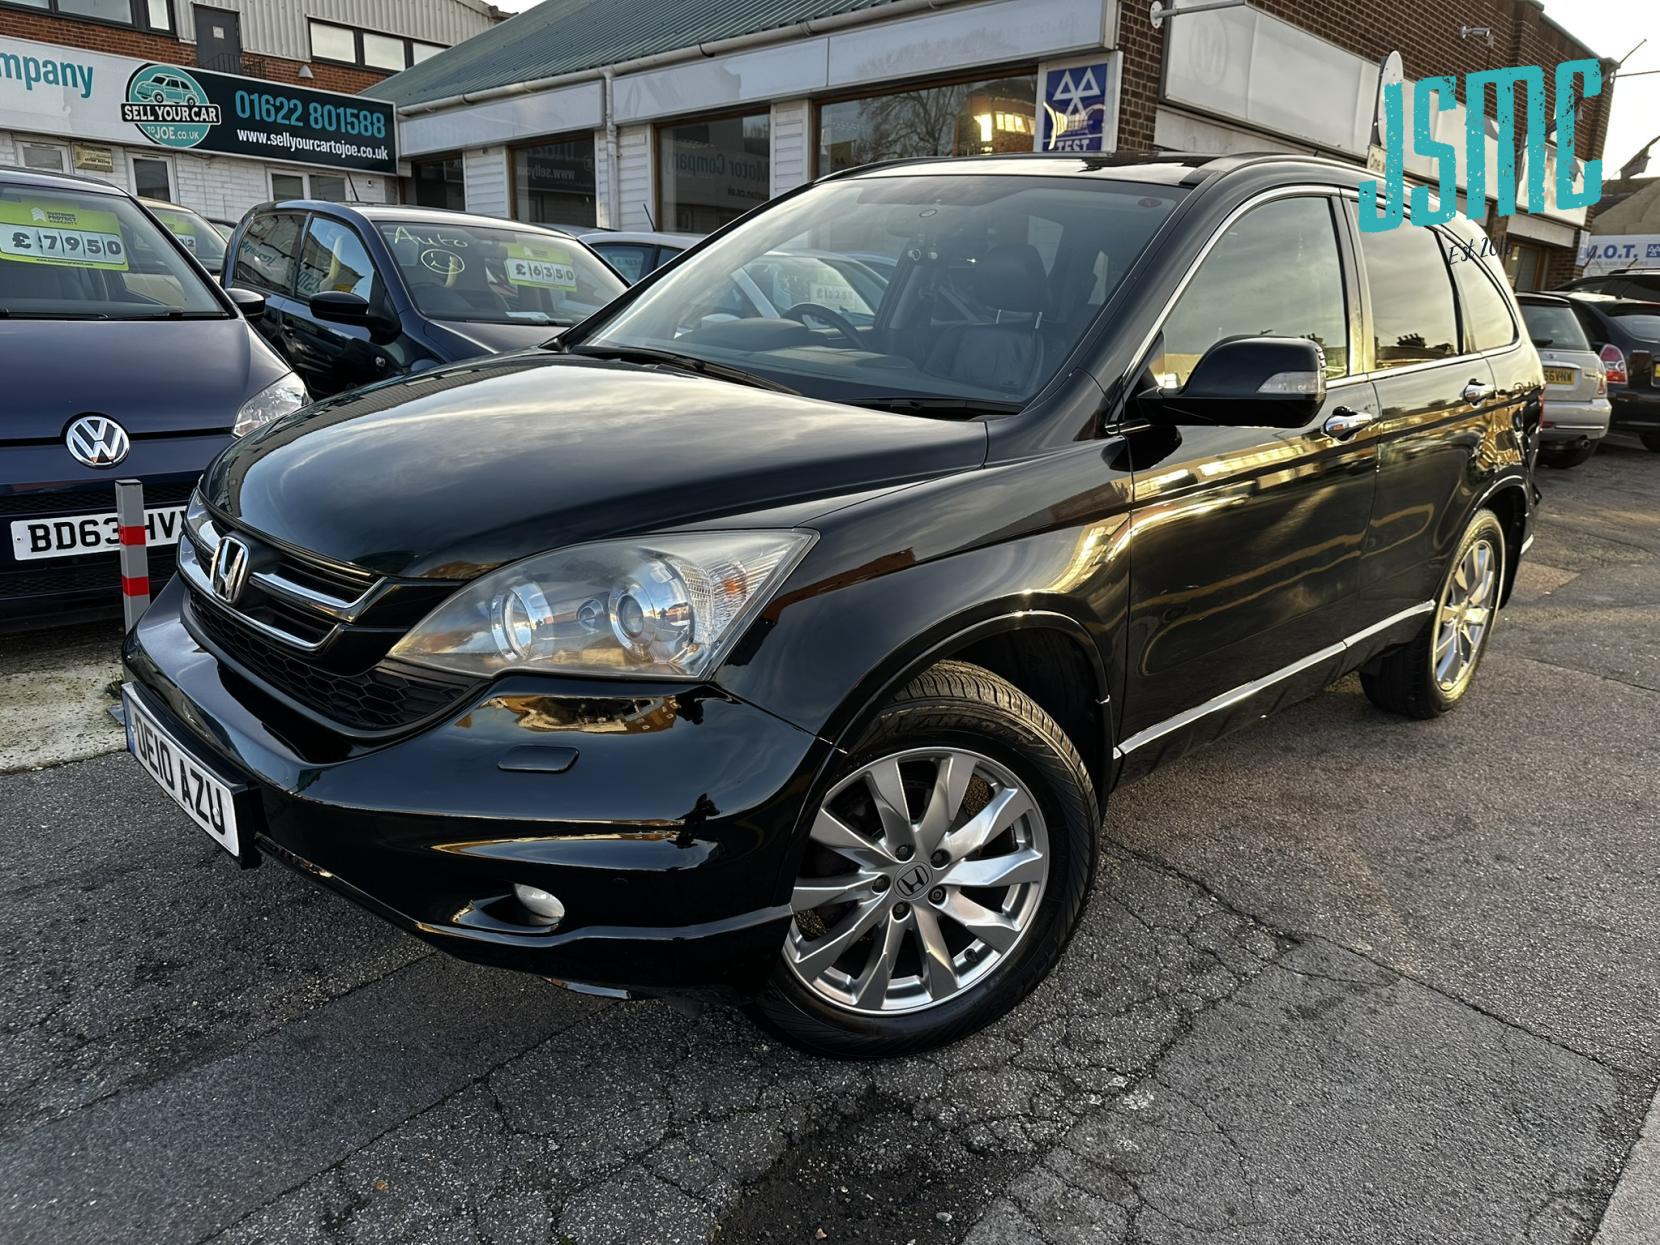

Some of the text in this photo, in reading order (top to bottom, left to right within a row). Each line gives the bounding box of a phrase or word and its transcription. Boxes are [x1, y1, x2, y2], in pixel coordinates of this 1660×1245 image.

[124, 105, 217, 122] SELL YOUR CAR
[235, 90, 385, 138] 01622 801588
[237, 128, 388, 160] www.sellyourcartojoe.co.uk
[1056, 138, 1090, 152] TEST
[394, 226, 469, 248] Auto
[27, 510, 187, 553] BD63 HV
[180, 758, 226, 836] AZU
